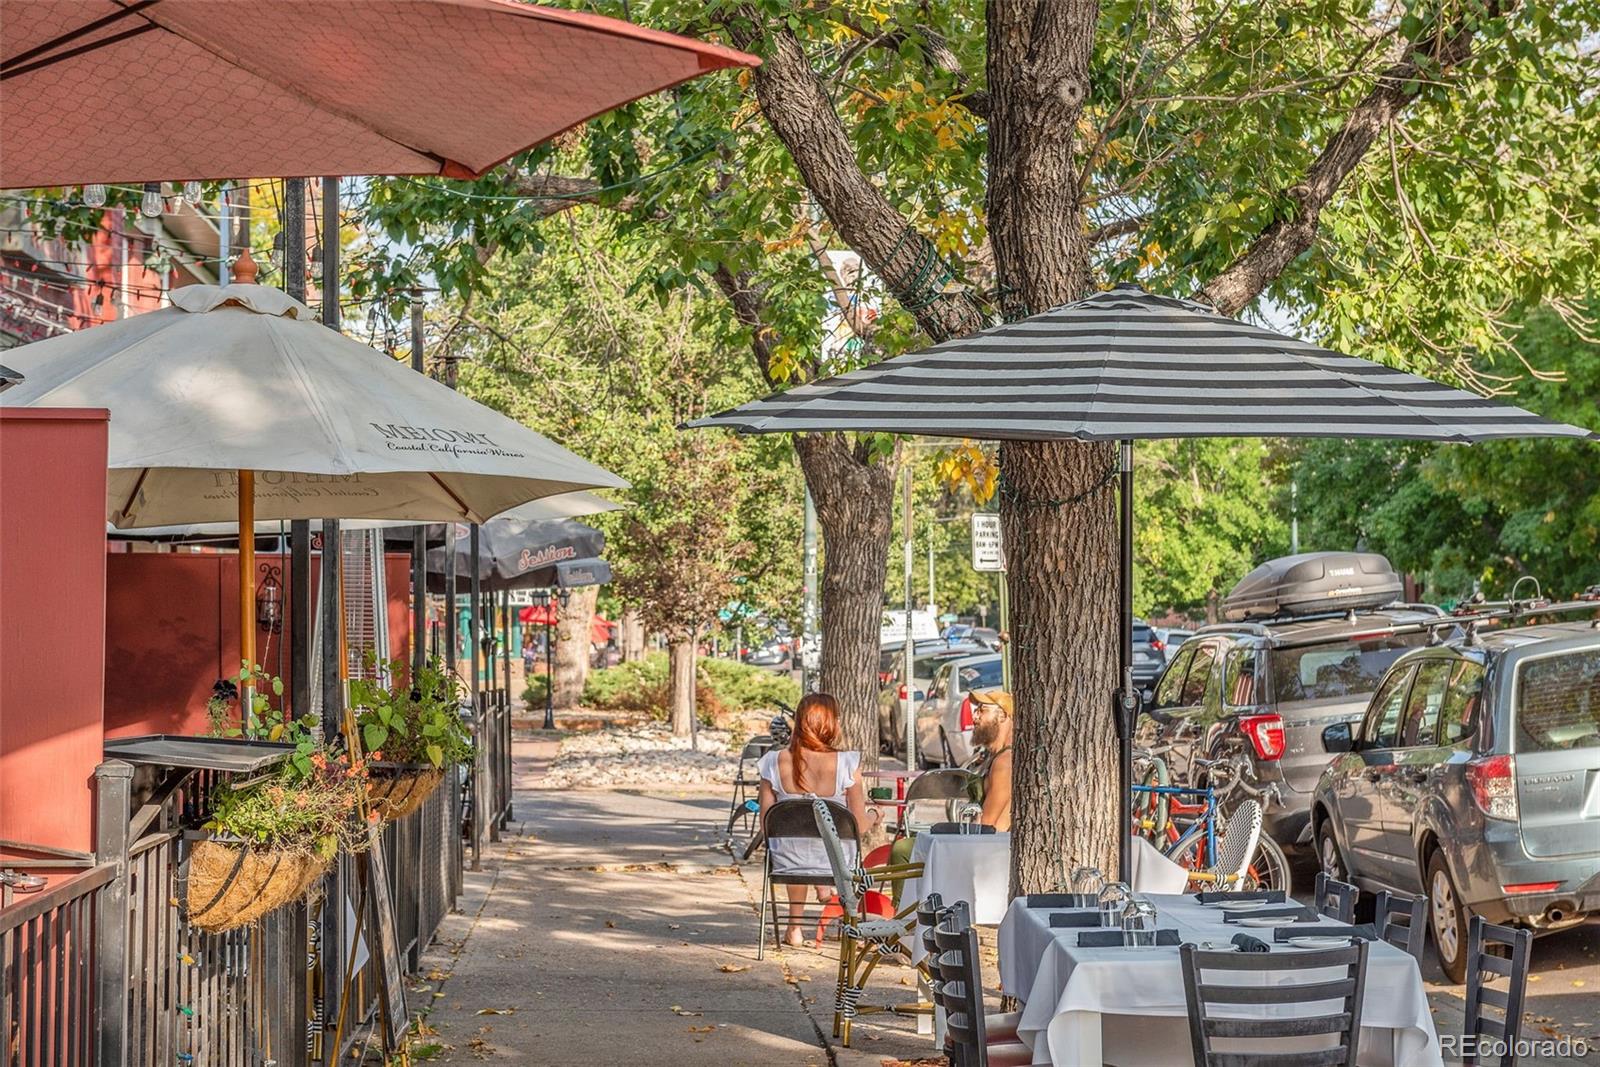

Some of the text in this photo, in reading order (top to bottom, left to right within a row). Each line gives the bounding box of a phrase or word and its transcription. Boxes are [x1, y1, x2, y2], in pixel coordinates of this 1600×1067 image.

[369, 422, 499, 447] MEIOMI
[386, 441, 525, 459] Coastal California Wines
[976, 531, 999, 539] PARKING
[519, 545, 574, 570] Session
